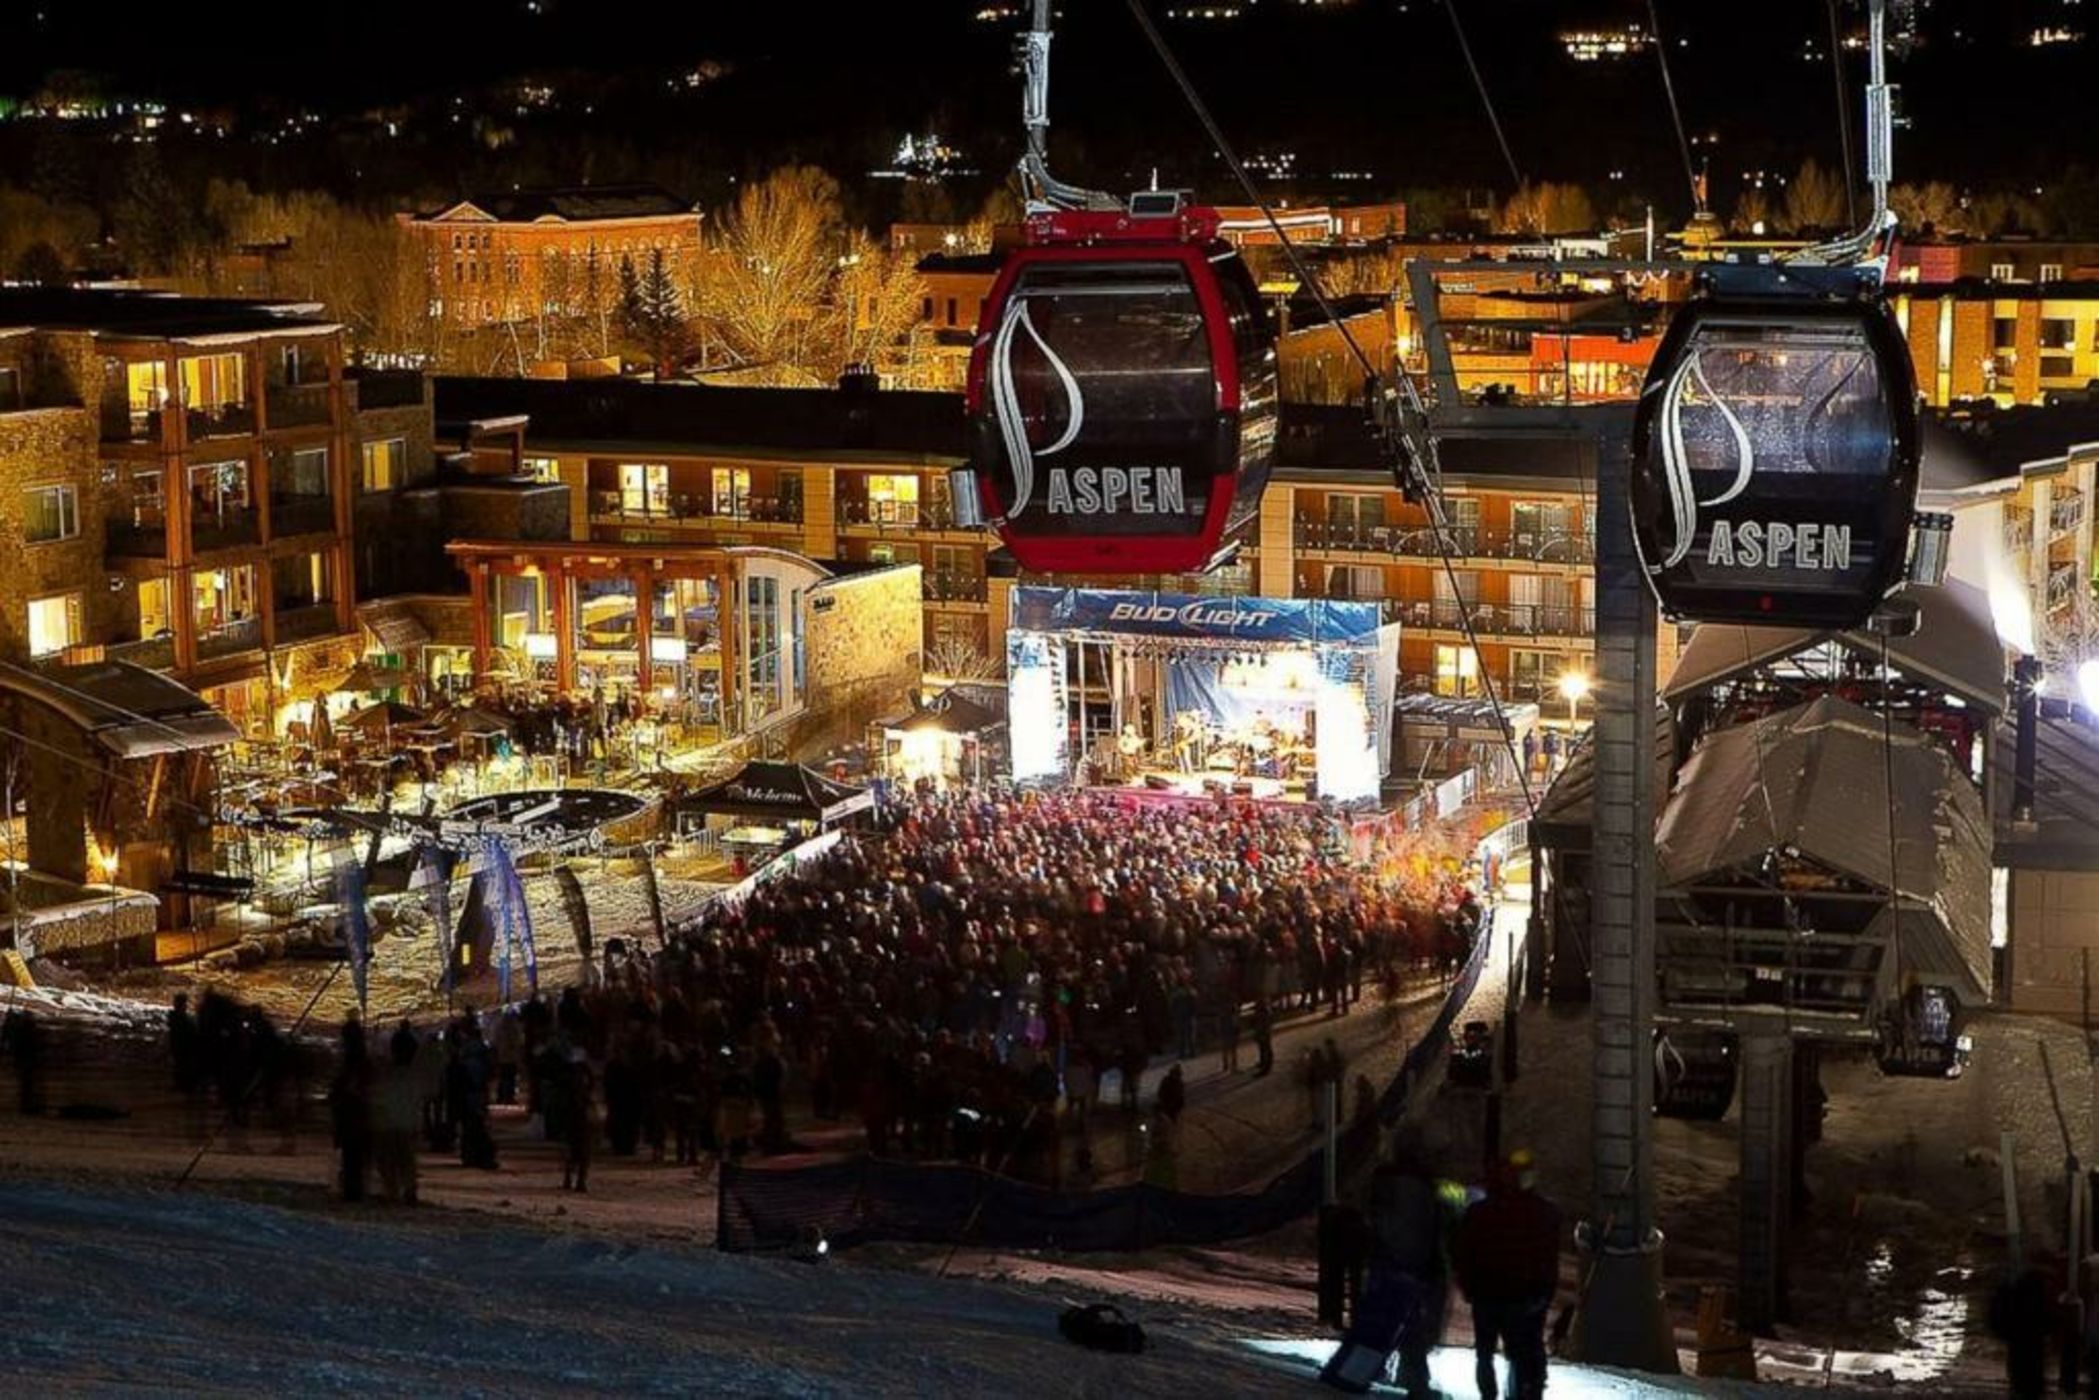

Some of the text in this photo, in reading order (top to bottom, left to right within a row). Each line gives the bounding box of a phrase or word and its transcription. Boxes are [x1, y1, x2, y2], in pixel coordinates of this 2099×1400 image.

[1048, 467, 1184, 514] ASPEN
[1707, 520, 1851, 570] ASPEN
[1109, 603, 1278, 627] BUD LIGHT
